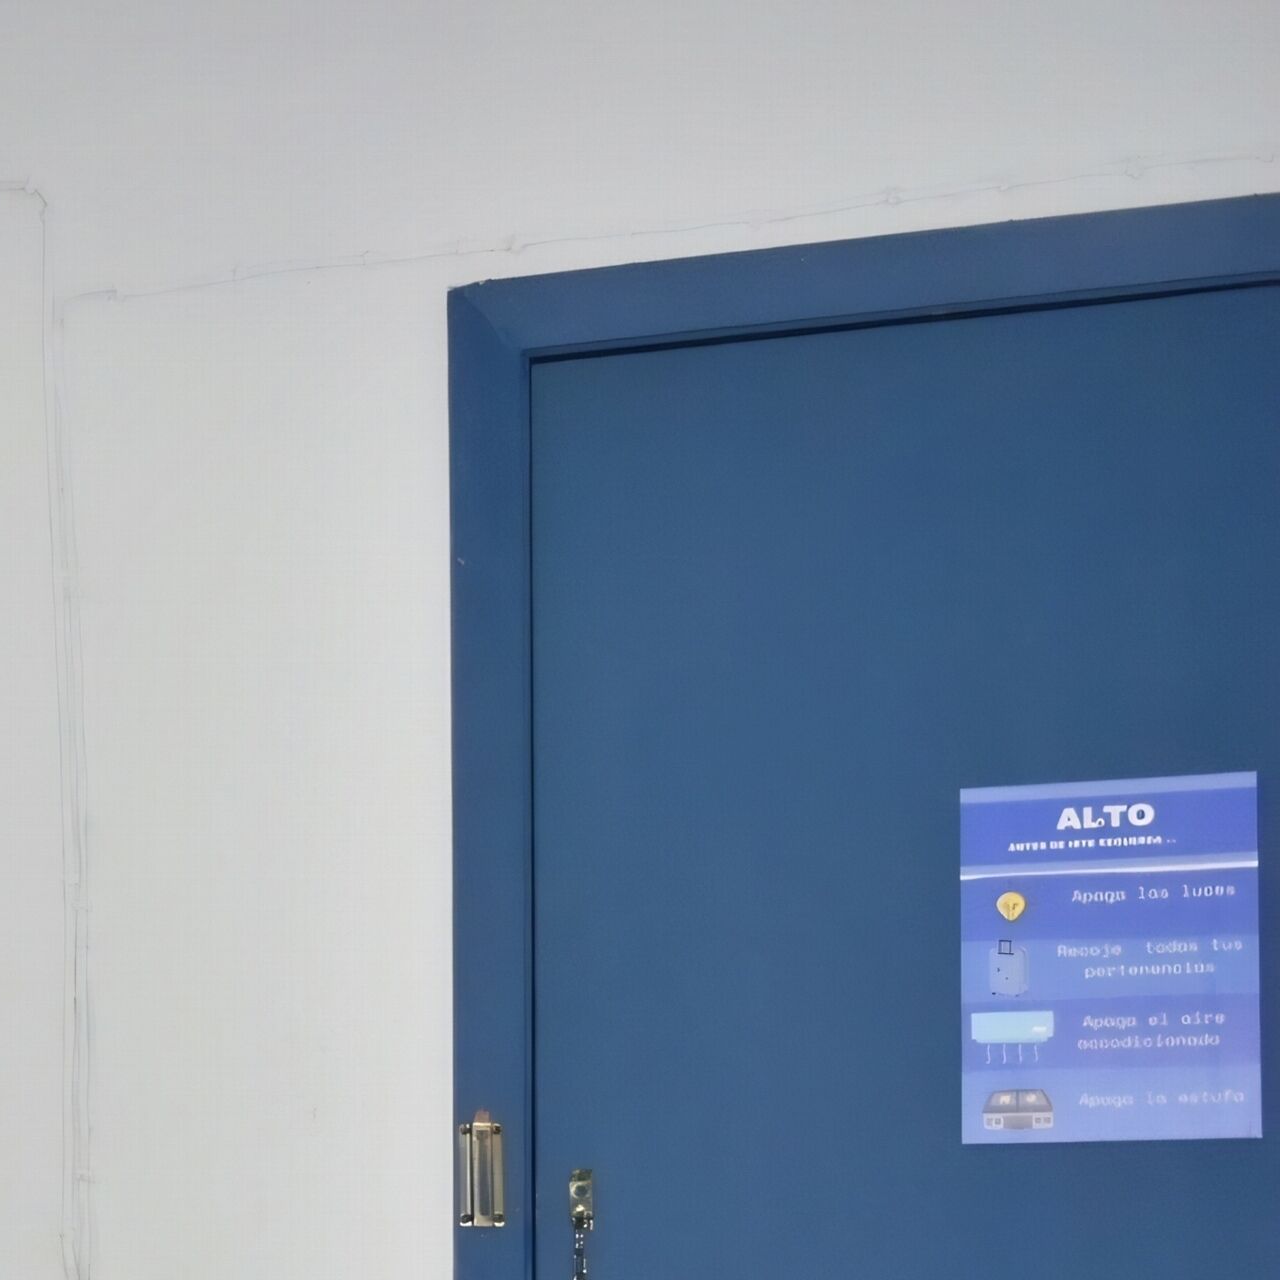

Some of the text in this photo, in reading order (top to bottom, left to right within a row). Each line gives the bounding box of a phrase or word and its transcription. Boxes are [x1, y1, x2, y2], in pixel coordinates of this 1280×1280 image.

[1056, 803, 1155, 830] ALTO
[1138, 886, 1169, 900] las
[1181, 1011, 1226, 1025] aire
